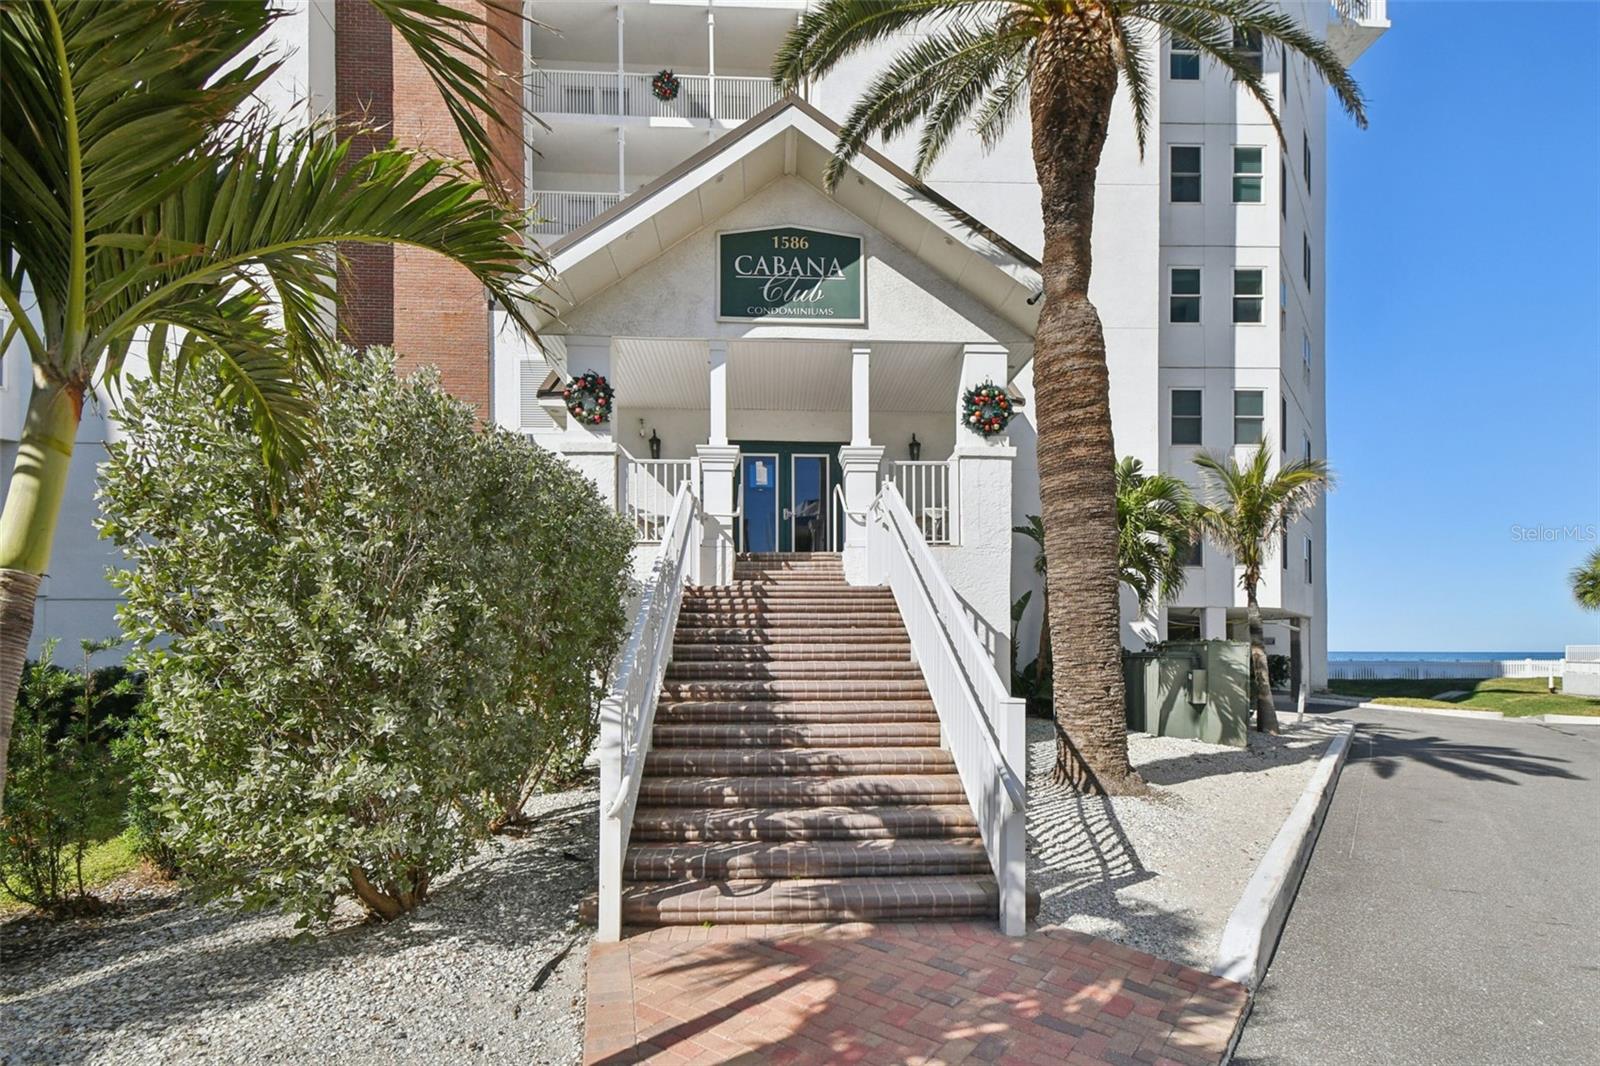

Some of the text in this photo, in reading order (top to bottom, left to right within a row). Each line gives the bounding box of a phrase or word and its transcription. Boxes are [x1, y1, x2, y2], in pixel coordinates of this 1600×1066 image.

[772, 235, 809, 249] 1586
[734, 255, 846, 277] CABANA
[759, 272, 825, 303] Club
[747, 306, 834, 316] CONDOMINIUMS
